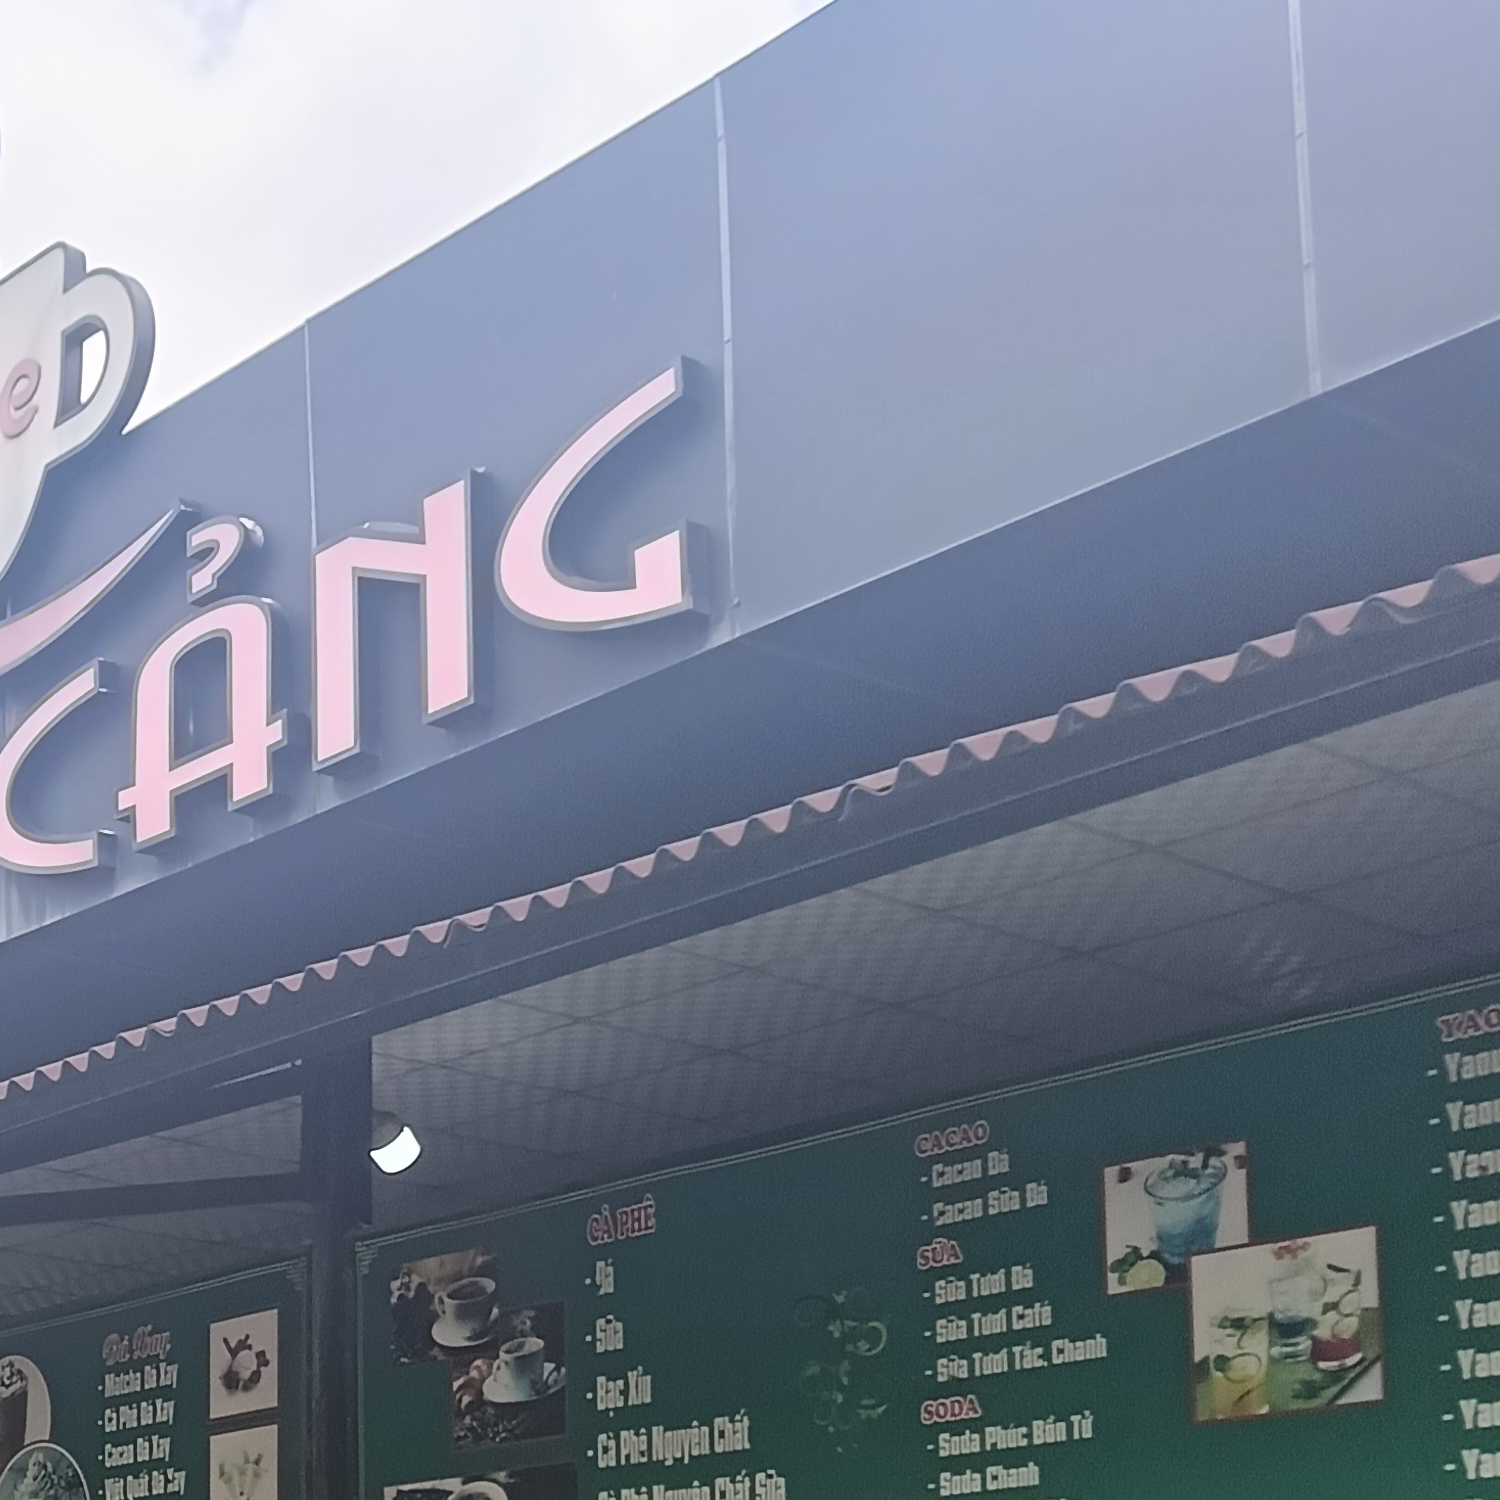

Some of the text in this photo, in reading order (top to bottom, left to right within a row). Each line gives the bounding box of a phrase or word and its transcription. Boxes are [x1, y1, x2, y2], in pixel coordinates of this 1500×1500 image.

[915, 1120, 990, 1157] CACAO
[932, 1148, 1009, 1188] Cacao Đá
[587, 1193, 656, 1246] CÀ PHÊ
[933, 1180, 1048, 1226] Cacao Sữa Đá
[917, 1237, 963, 1270] SỮA
[595, 1257, 614, 1296] Đá
[935, 1263, 1033, 1304] Sữa Tươi Đá
[595, 1314, 624, 1353] Sữa
[936, 1300, 1052, 1343] Sữa Tươi Café
[937, 1354, 968, 1382] Sữa
[972, 1347, 1008, 1377] Tươi
[1051, 1333, 1107, 1364] Chanh
[104, 1369, 141, 1398] Matcha
[159, 1362, 178, 1389] Xay
[596, 1365, 652, 1418] Bạc Xỉu
[104, 1407, 117, 1433] Cà
[119, 1403, 138, 1430] Phê
[155, 1398, 175, 1425] Xay
[921, 1394, 982, 1424] SODA
[105, 1443, 134, 1468] Cacao
[151, 1434, 171, 1462] Xay
[597, 1408, 750, 1468] Cà Phê Nguyên Chất
[939, 1430, 980, 1457] Soda
[985, 1423, 1028, 1451] Phúc
[1070, 1410, 1093, 1440] Tử
[940, 1461, 1039, 1496] Soda Chanh
